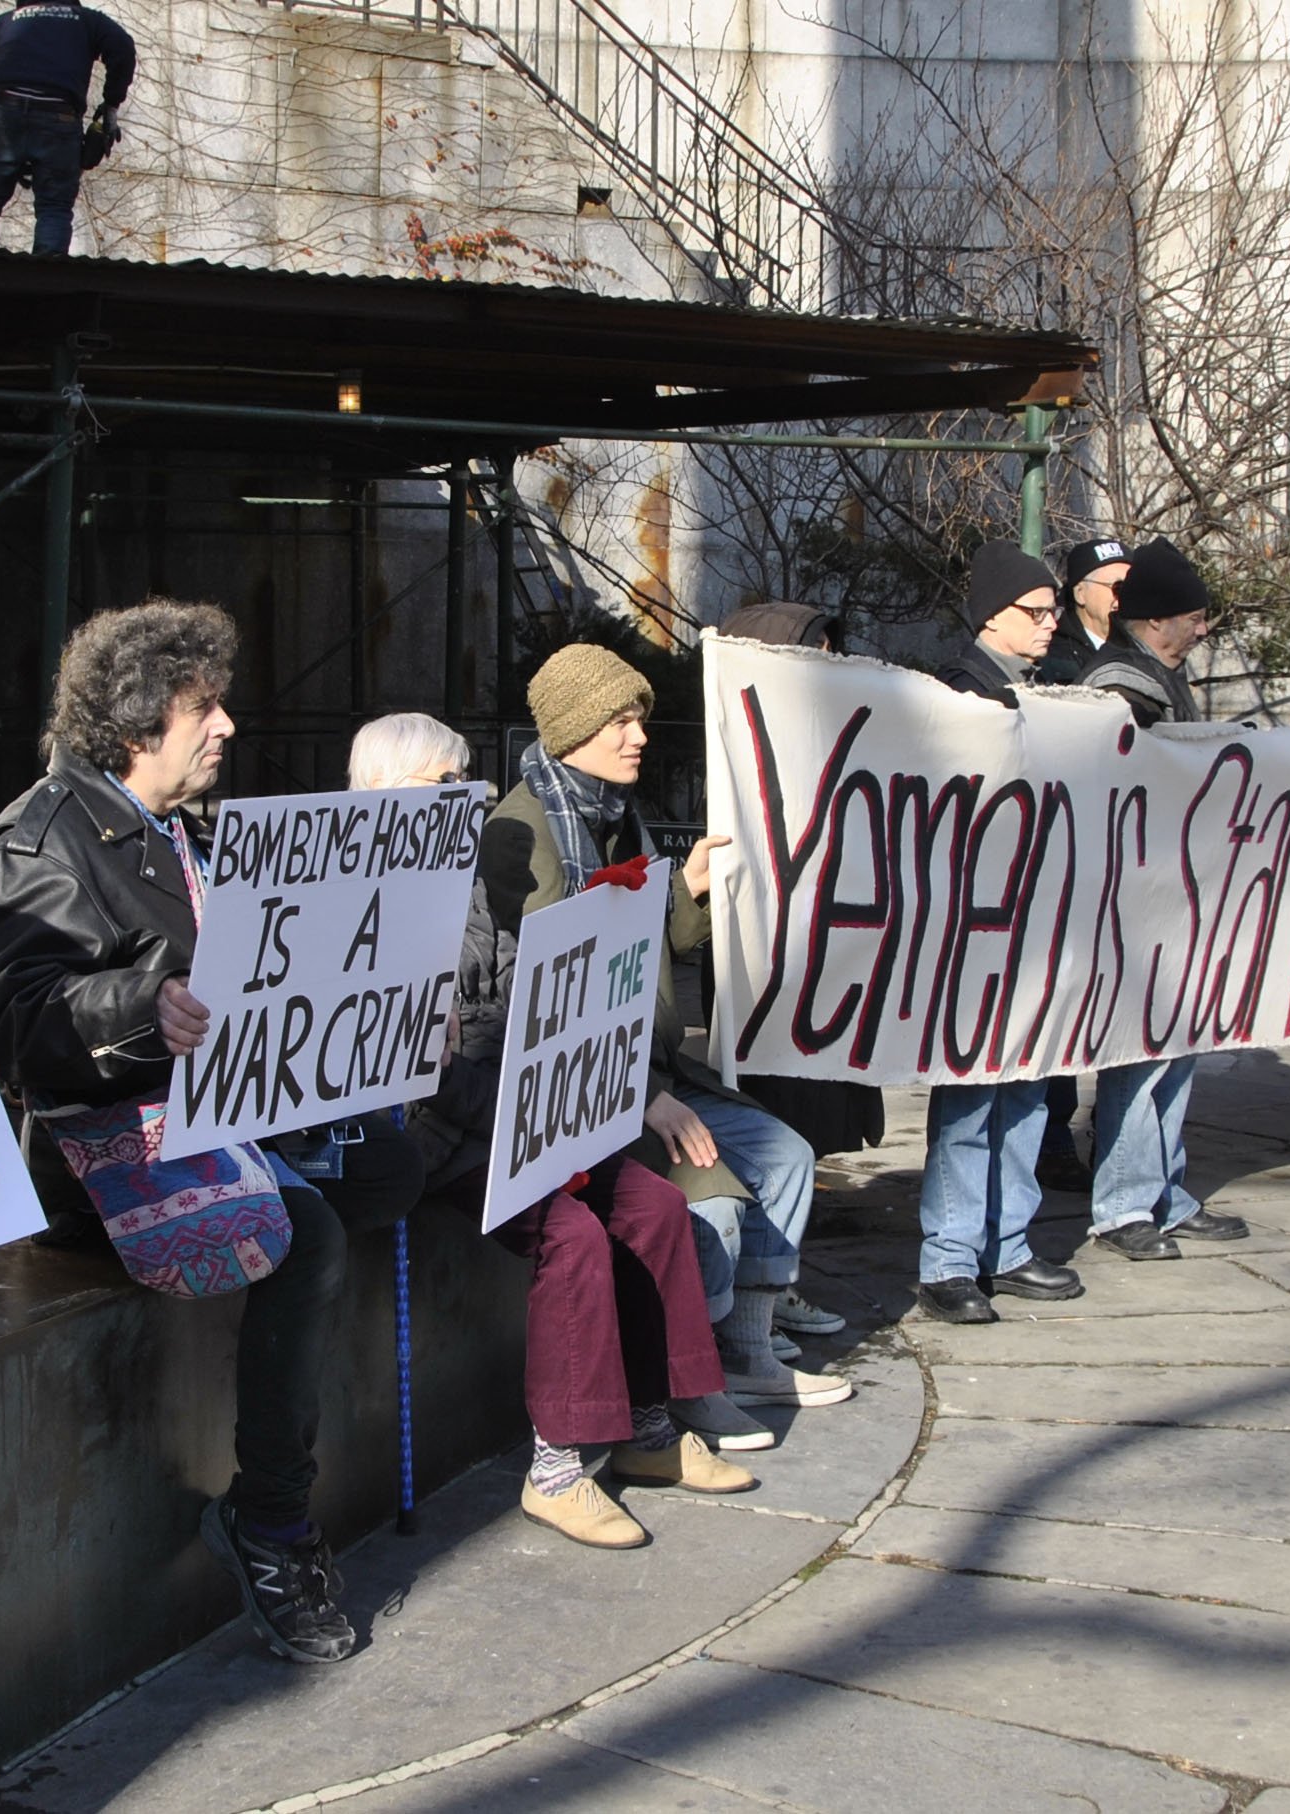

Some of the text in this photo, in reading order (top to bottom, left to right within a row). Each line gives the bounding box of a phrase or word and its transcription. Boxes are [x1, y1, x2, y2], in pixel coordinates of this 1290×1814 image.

[213, 788, 487, 888] BOMBING HOSPITALS
[735, 684, 1077, 1077] Yemen
[1061, 722, 1149, 1068] is
[242, 887, 381, 994] IS A
[524, 936, 651, 1052] LIFT THE
[185, 970, 456, 1129] WAR CRIME
[509, 1016, 645, 1181] BLOCKADE
